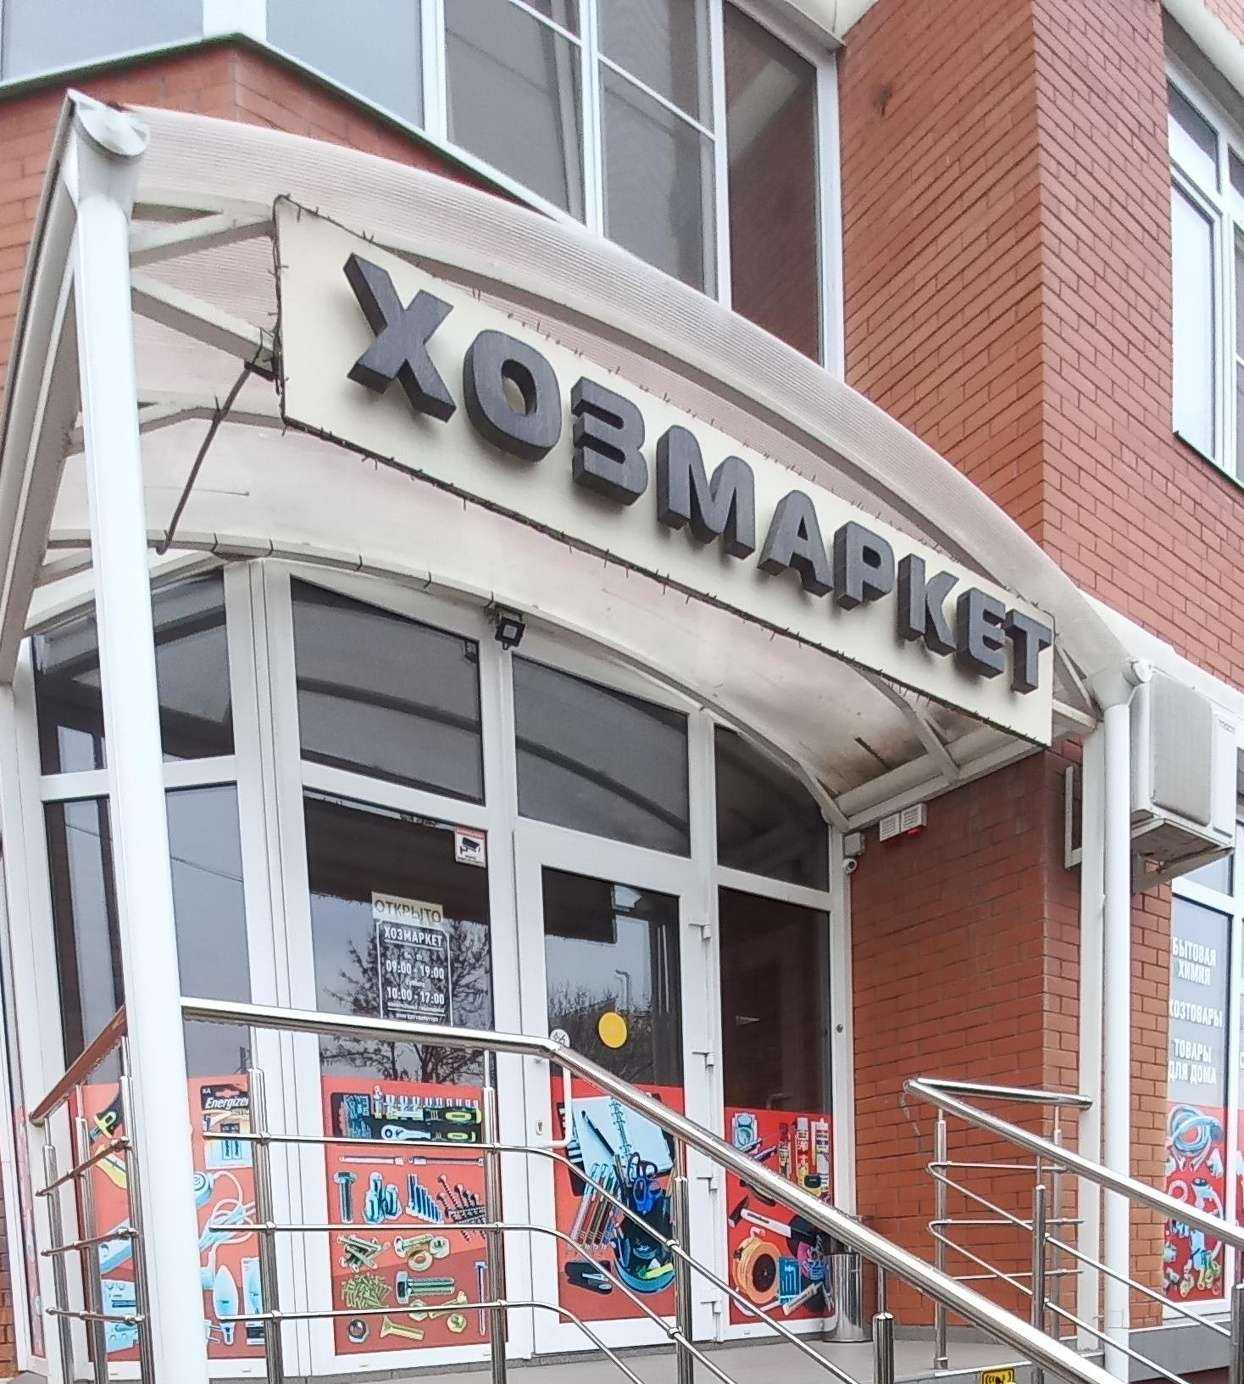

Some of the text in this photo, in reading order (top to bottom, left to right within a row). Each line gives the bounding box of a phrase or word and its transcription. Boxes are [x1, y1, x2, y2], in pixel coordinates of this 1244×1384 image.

[343, 252, 1053, 695] ХОЗМАРКЕТ
[375, 899, 442, 923] ОТКРЫТО
[384, 924, 443, 947] ХОЗМАРКЕТ
[1172, 935, 1217, 966] БЫТОВАЯ
[386, 959, 412, 975] 09:00
[420, 964, 445, 979] 19:00
[1179, 958, 1211, 986] ХИМИЯ
[386, 986, 413, 1001] 10:00
[420, 991, 445, 1005] 17:00
[1174, 1038, 1212, 1063] ТОВАРЫ
[1168, 1060, 1217, 1086] ДЛЯ ДОМА
